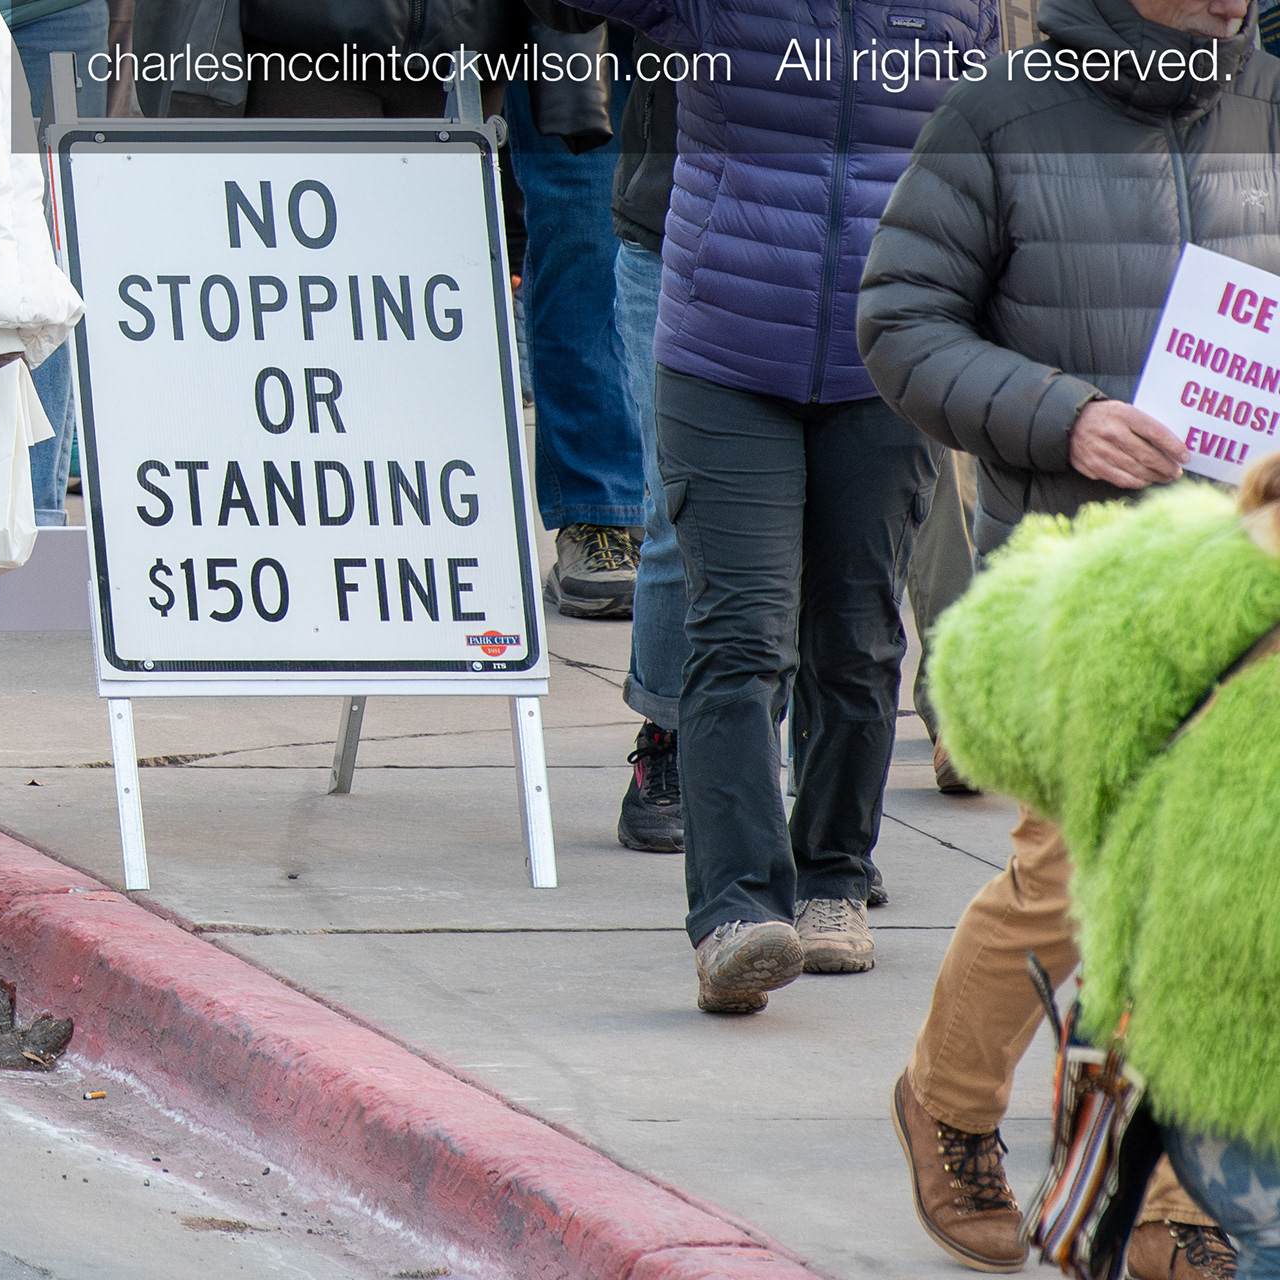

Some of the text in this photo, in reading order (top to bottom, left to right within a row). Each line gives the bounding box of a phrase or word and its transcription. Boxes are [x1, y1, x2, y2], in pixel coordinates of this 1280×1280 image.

[226, 180, 337, 249] NO
[117, 274, 465, 343] STOPPING
[1216, 281, 1279, 335] ICE
[1165, 327, 1280, 395] IGNORAN
[255, 366, 346, 436] OR
[1180, 380, 1280, 437] CHAOS!
[1185, 426, 1250, 466] EVIL!
[135, 459, 480, 528] STANDING
[148, 556, 487, 623] $150 FINE
[469, 635, 518, 644] PARK CITY
[492, 662, 507, 670] ITS
